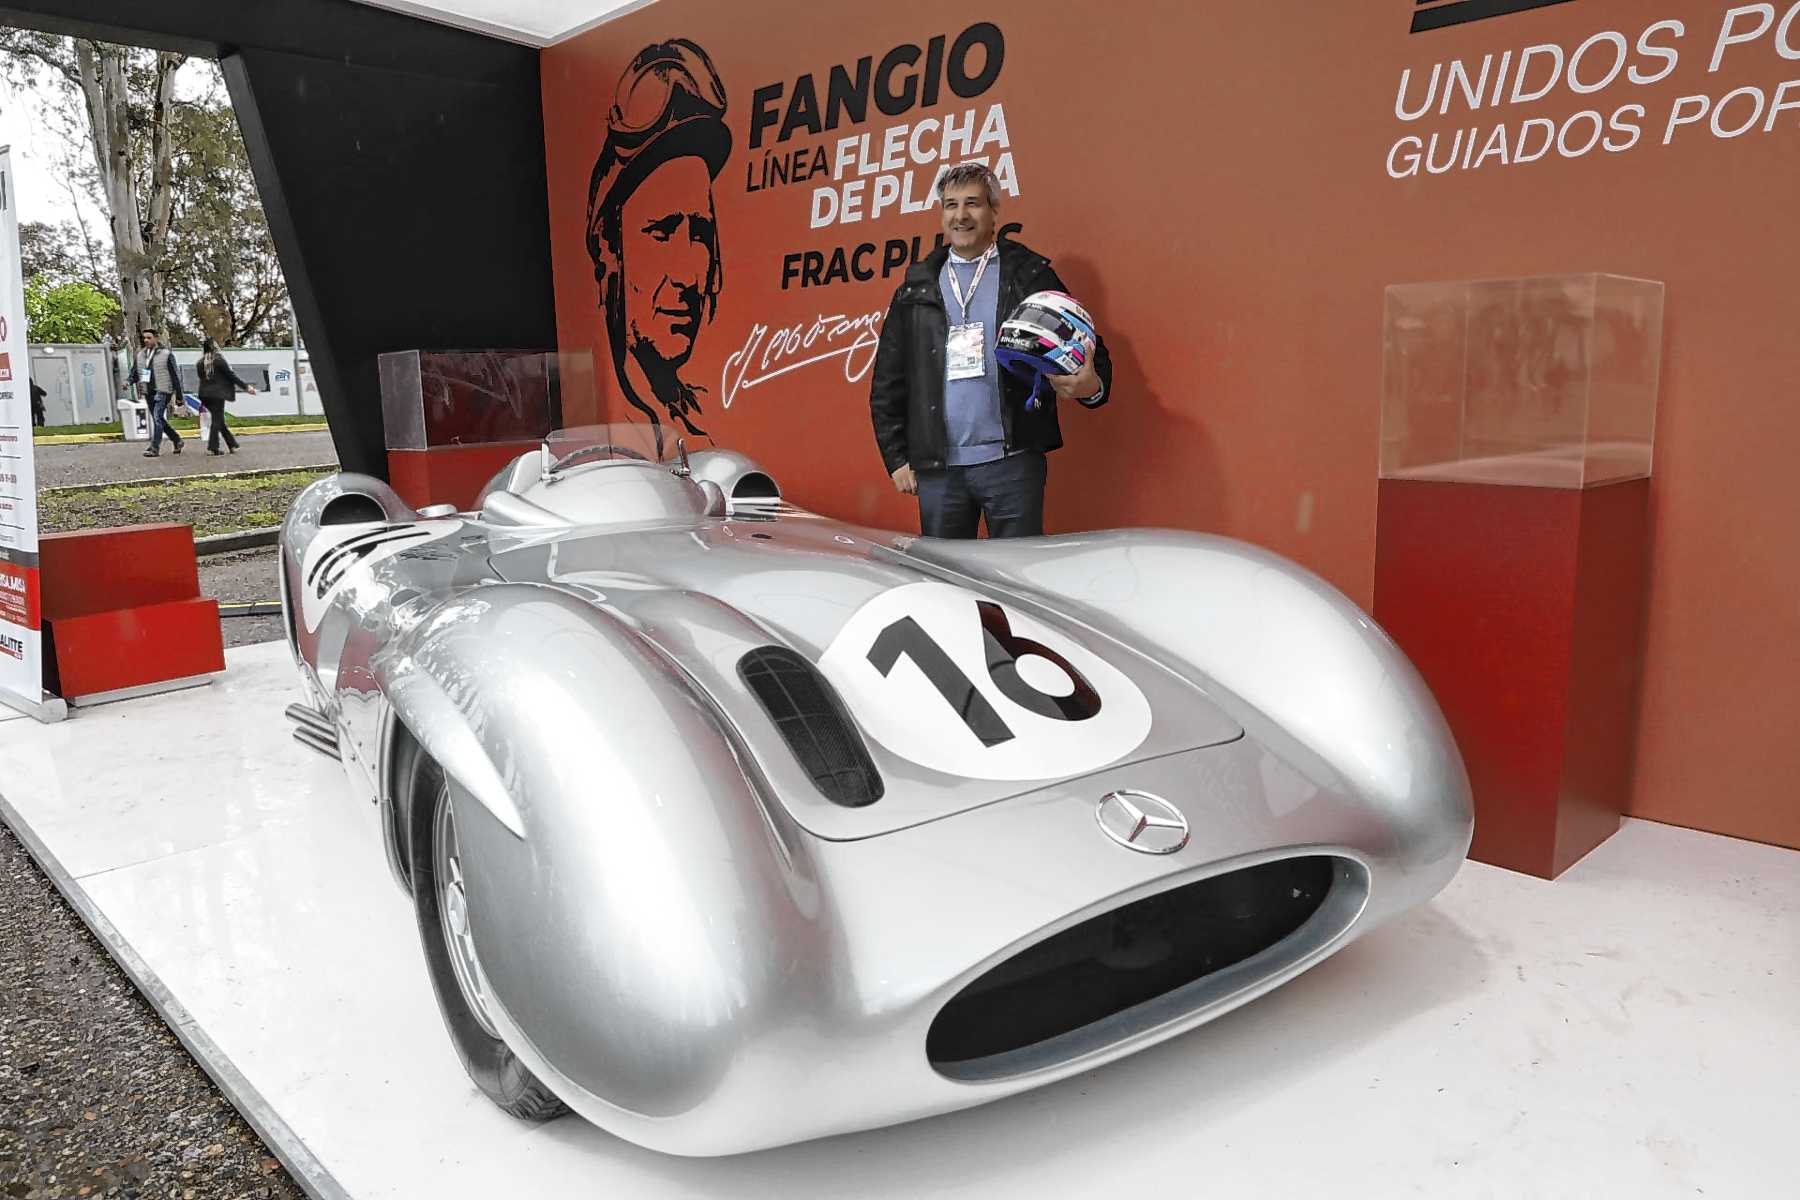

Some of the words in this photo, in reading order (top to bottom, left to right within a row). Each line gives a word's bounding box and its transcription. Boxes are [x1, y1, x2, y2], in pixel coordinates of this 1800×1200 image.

[748, 22, 1005, 149] FANGIO
[1394, 20, 1685, 121] UNIDOS
[746, 145, 829, 192] LÍNEA
[833, 103, 1010, 181] FLECHA
[1386, 104, 1645, 179] GUIADOS
[810, 180, 866, 229] DE
[871, 152, 1020, 219] PLAA
[781, 243, 877, 290] FRAC
[866, 599, 1102, 748] 16
